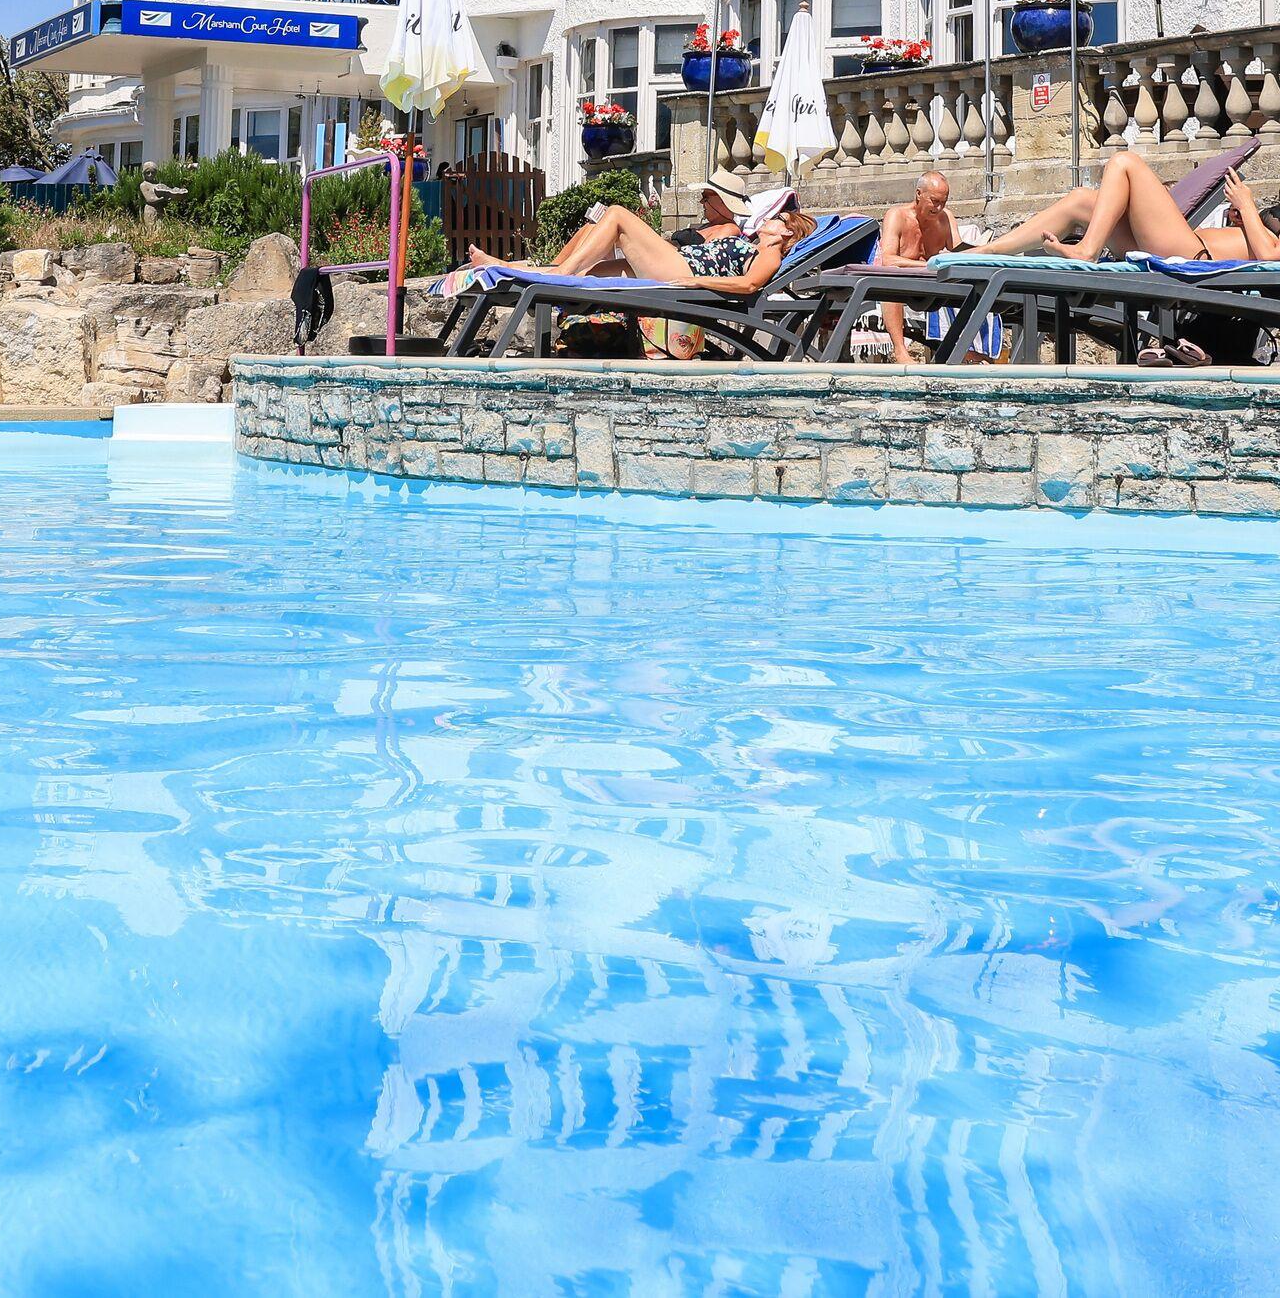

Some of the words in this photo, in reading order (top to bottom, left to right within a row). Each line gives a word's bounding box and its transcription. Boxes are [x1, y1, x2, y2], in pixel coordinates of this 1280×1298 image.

[182, 12, 240, 31] Marsham
[240, 16, 268, 33] Court
[267, 18, 301, 35] Hotel
